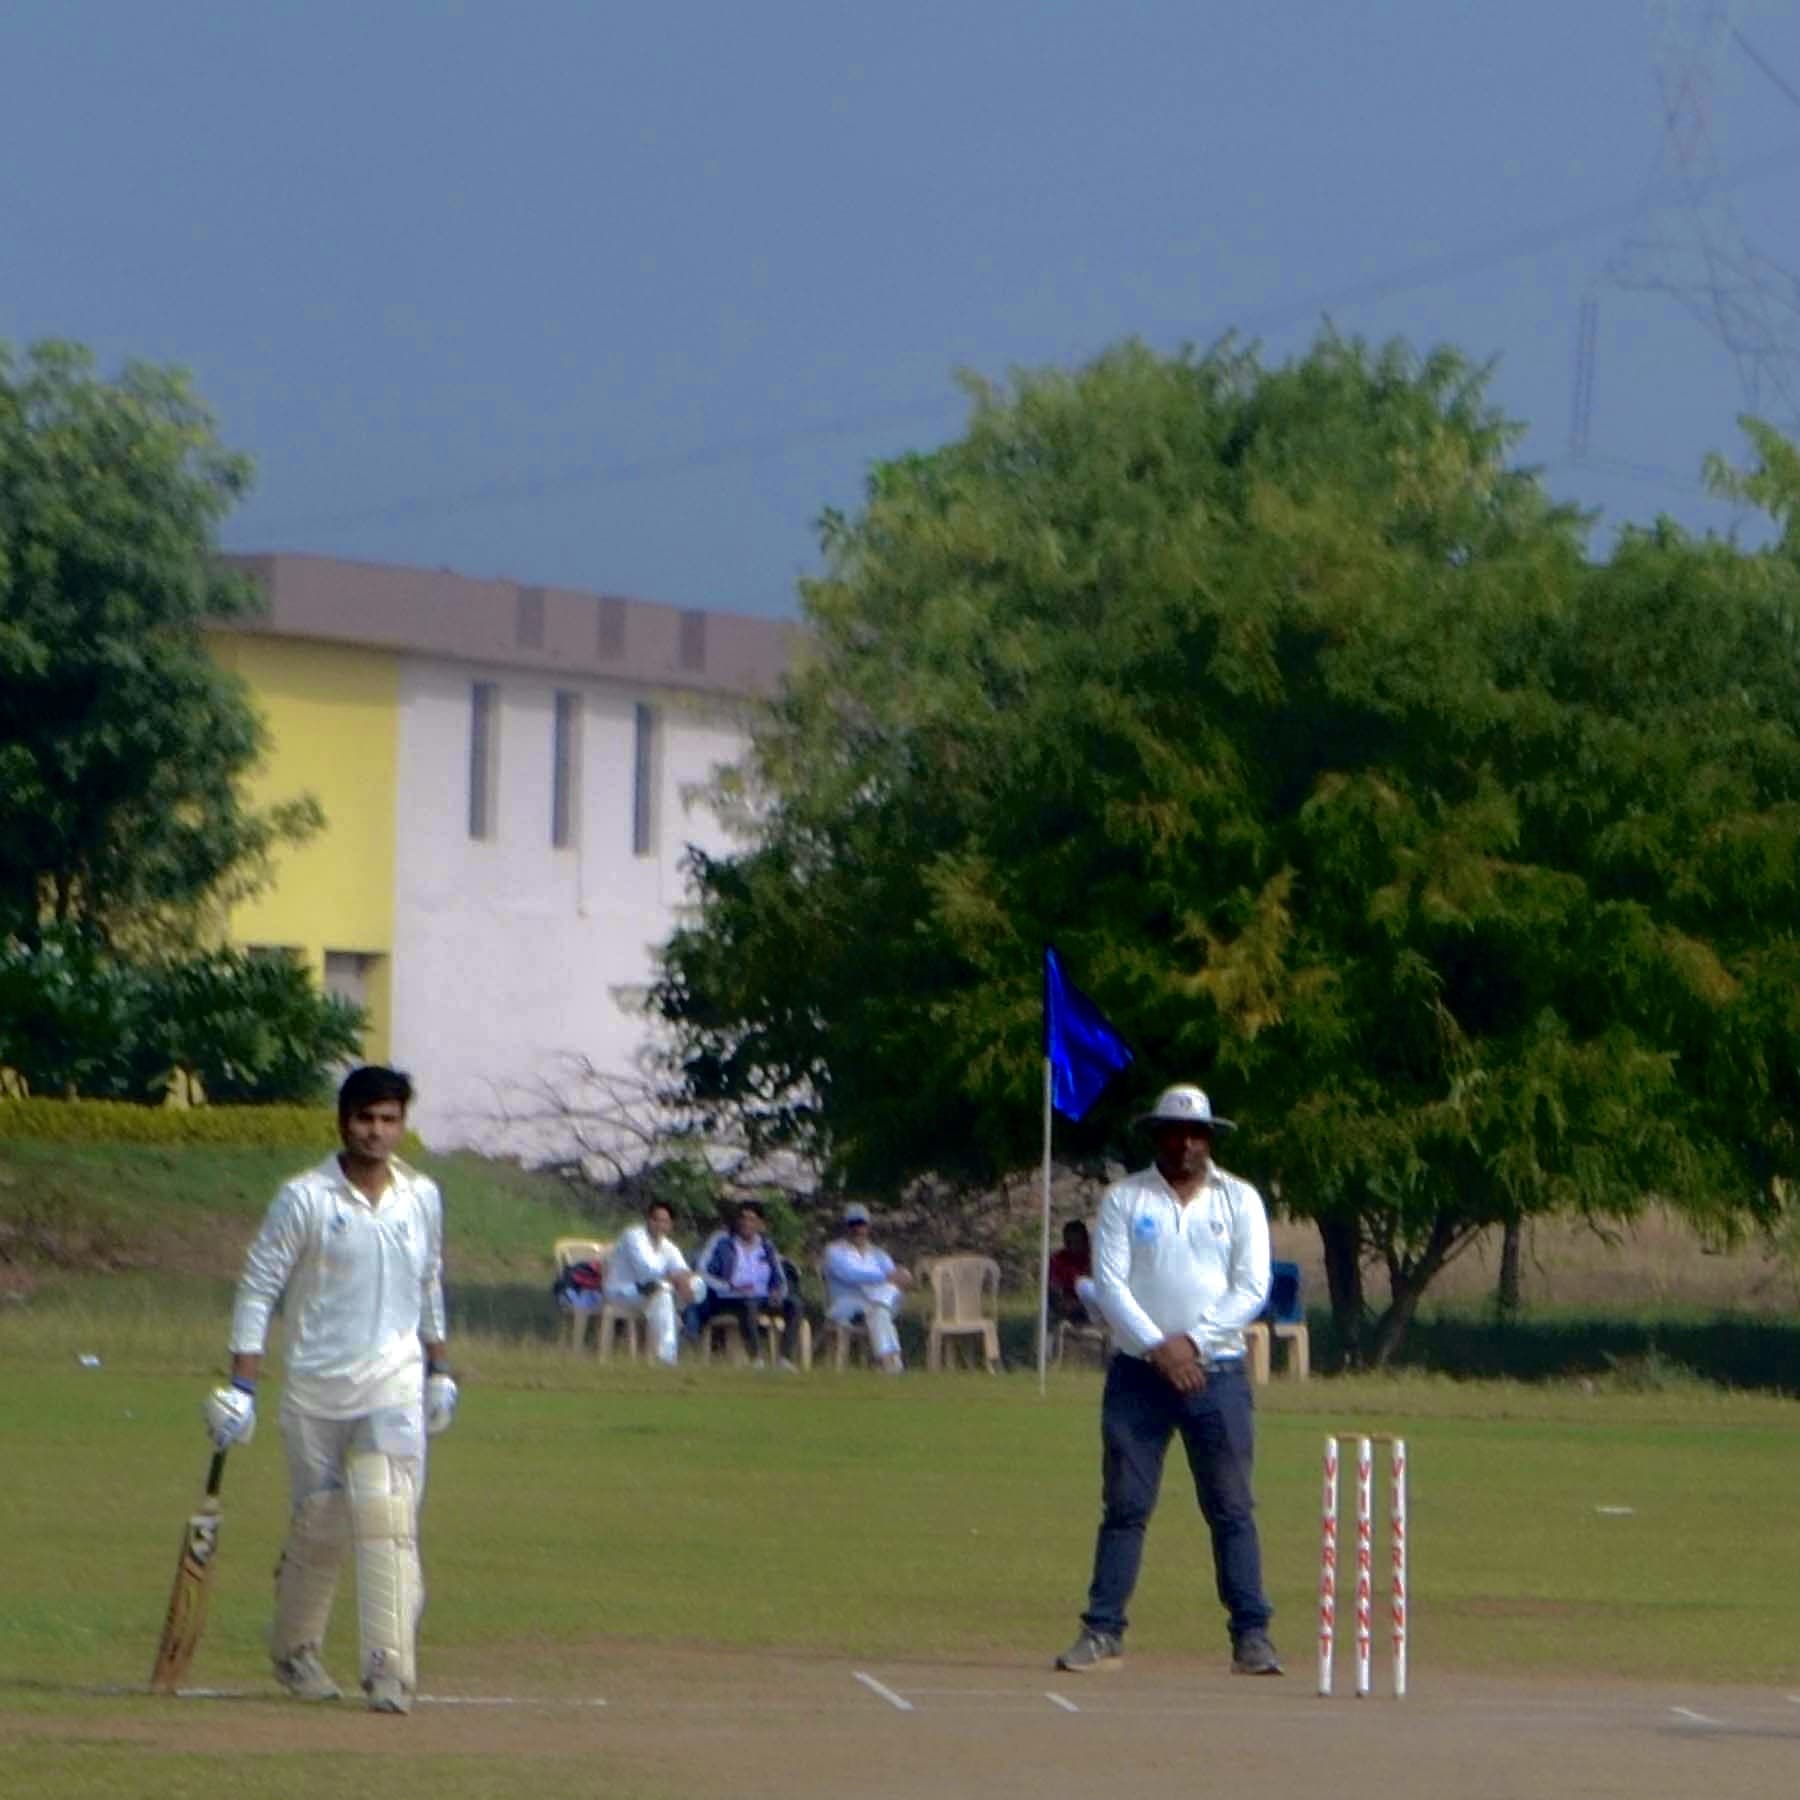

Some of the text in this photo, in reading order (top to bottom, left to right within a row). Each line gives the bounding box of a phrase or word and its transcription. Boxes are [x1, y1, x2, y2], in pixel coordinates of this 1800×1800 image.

[1320, 1457, 1338, 1657] VIKRANT
[1358, 1460, 1371, 1659] VIKRANT
[1391, 1457, 1404, 1657] VIKRANT
